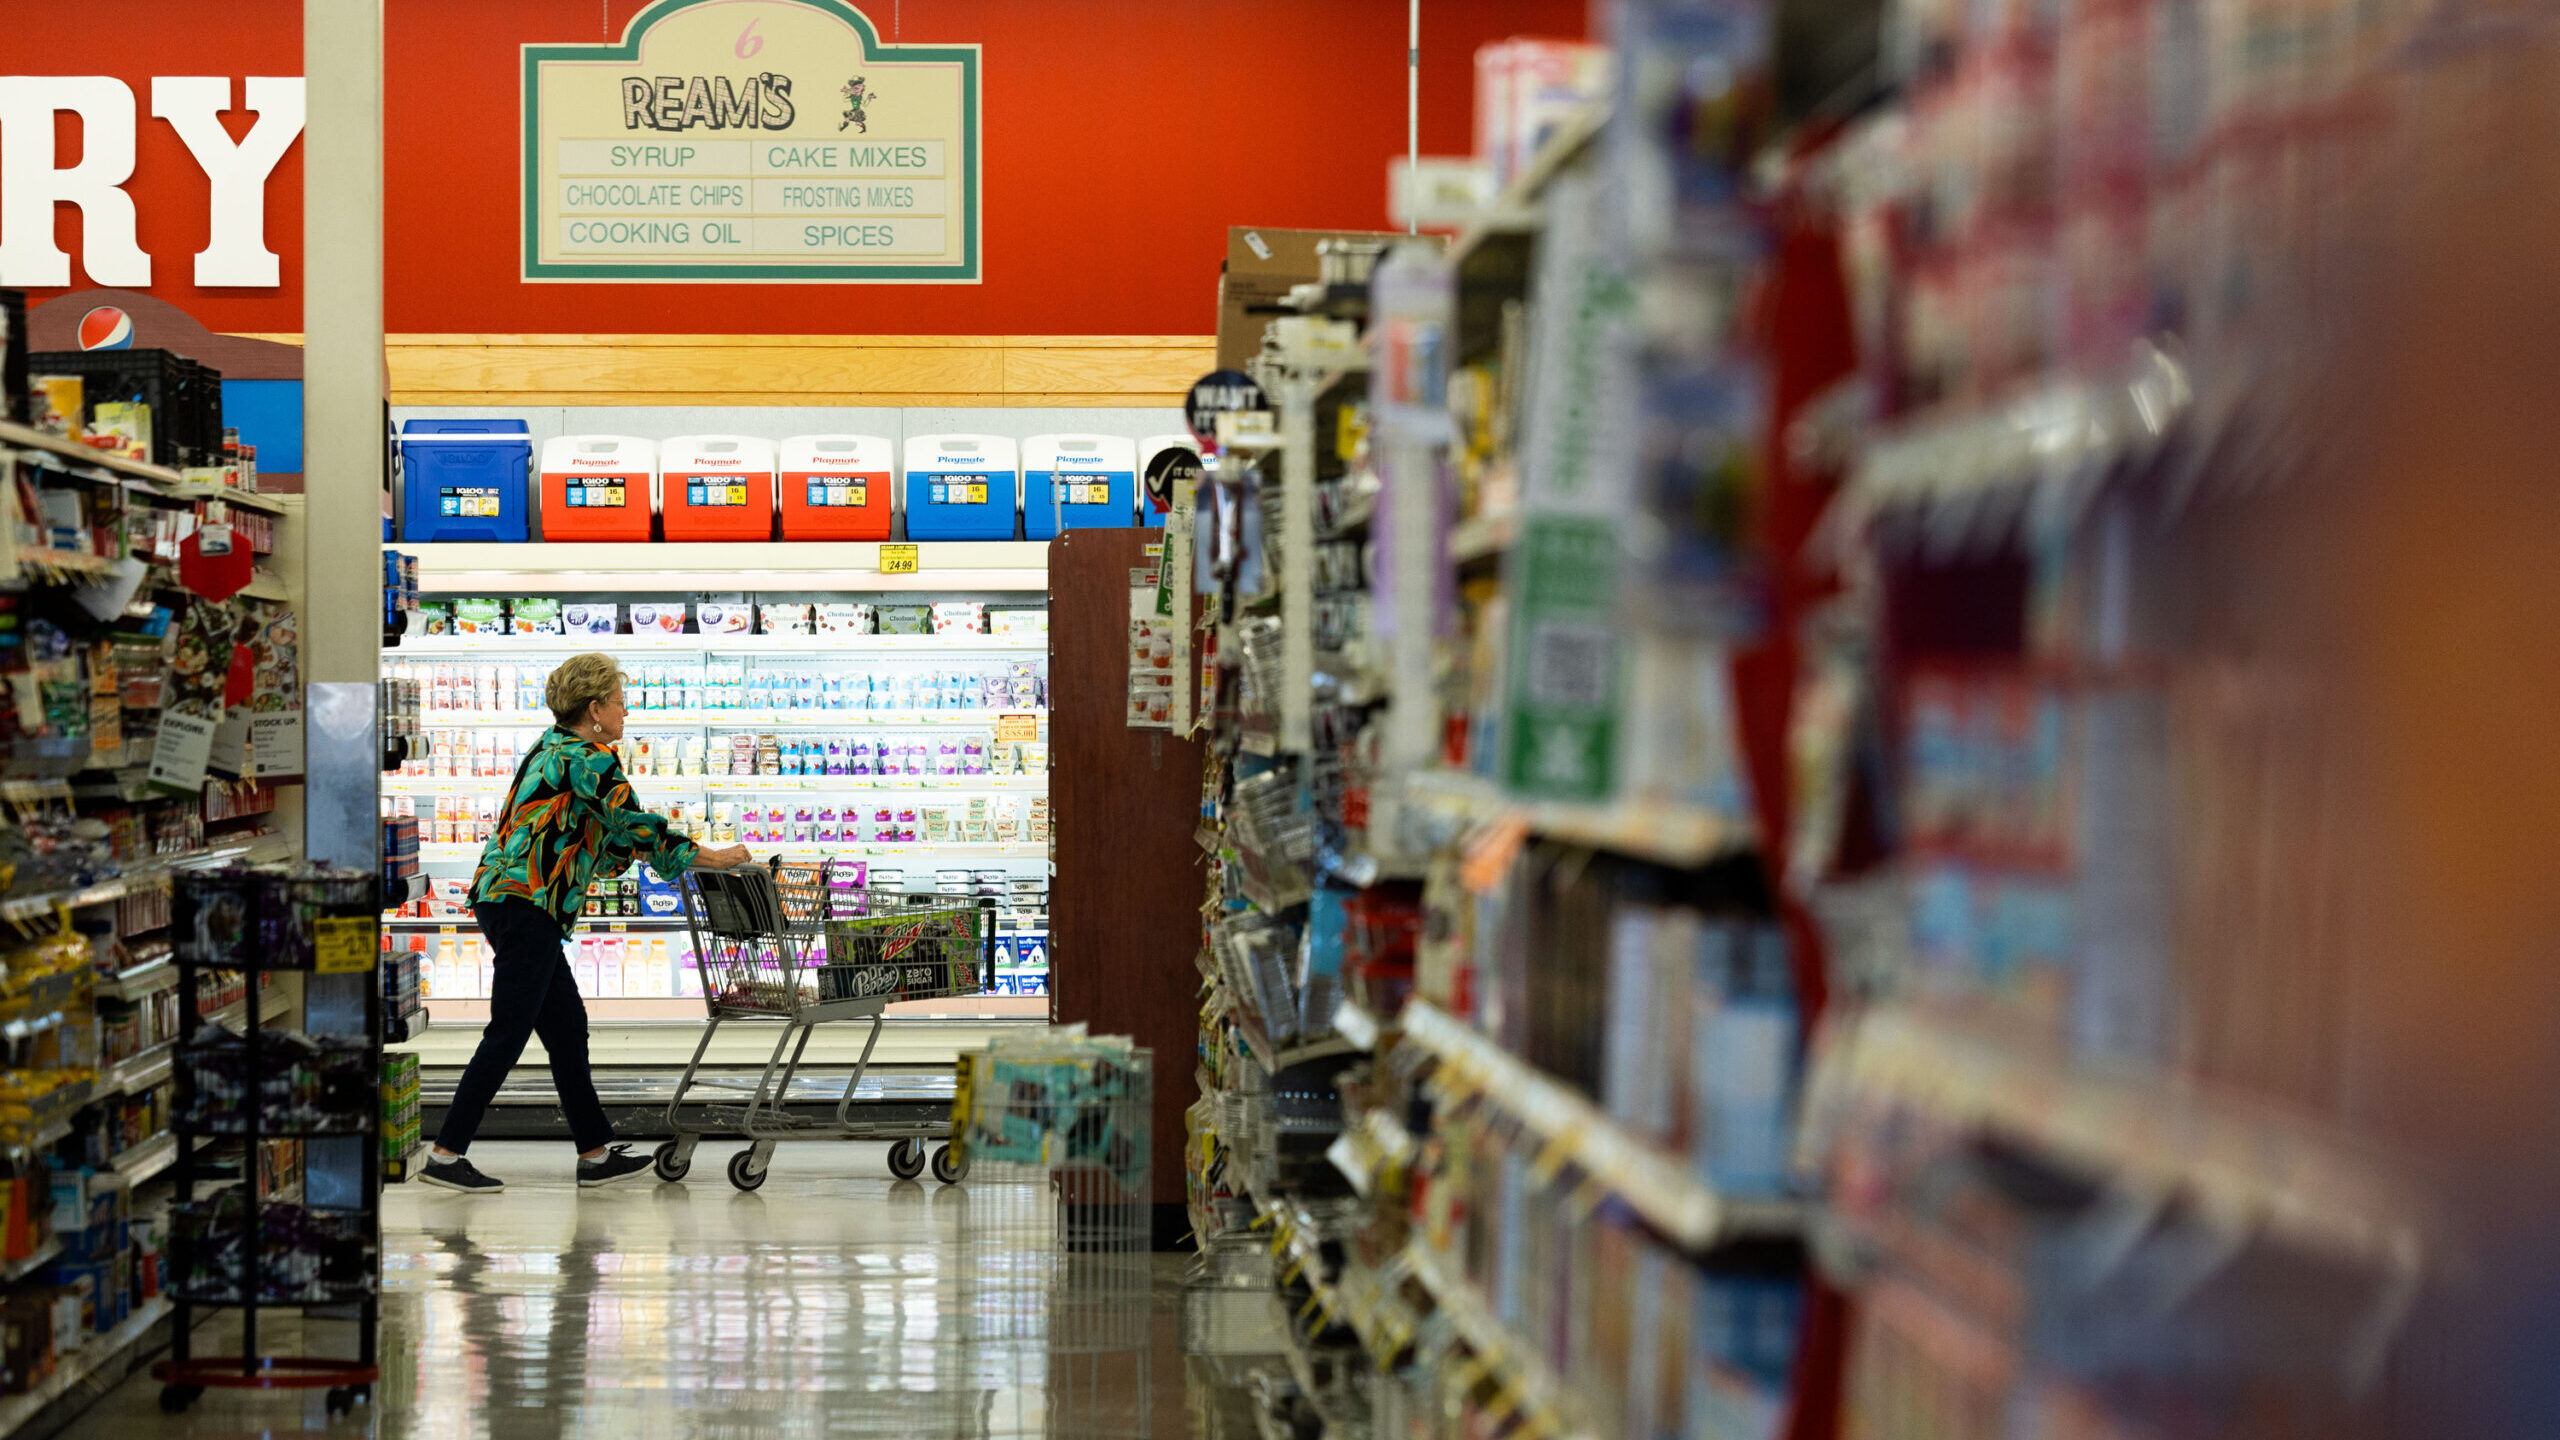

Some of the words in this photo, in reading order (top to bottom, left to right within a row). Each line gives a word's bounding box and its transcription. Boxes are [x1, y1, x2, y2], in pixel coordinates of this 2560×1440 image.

[734, 17, 764, 60] 6
[621, 72, 796, 132] REAM'S
[610, 146, 696, 168] SYRUP
[767, 147, 838, 168] CAKE
[849, 147, 927, 168] MIXES
[566, 185, 682, 207] CHOCOLATE
[689, 185, 744, 207] CHIPS
[782, 186, 861, 208] FROSTING
[867, 186, 914, 208] MIXES
[569, 223, 690, 245] COOKING
[702, 223, 741, 244] OIL
[803, 226, 894, 247] SPICES
[571, 458, 620, 467] Playmate
[694, 457, 742, 467] Playmate
[812, 456, 860, 465] Playmate
[937, 455, 985, 464] Playmate
[1056, 455, 1104, 464] Playmate
[1173, 466, 1182, 477] IT
[519, 604, 550, 613] ACTIVIA
[868, 965, 884, 980] Dr
[852, 970, 896, 997] Pepper
